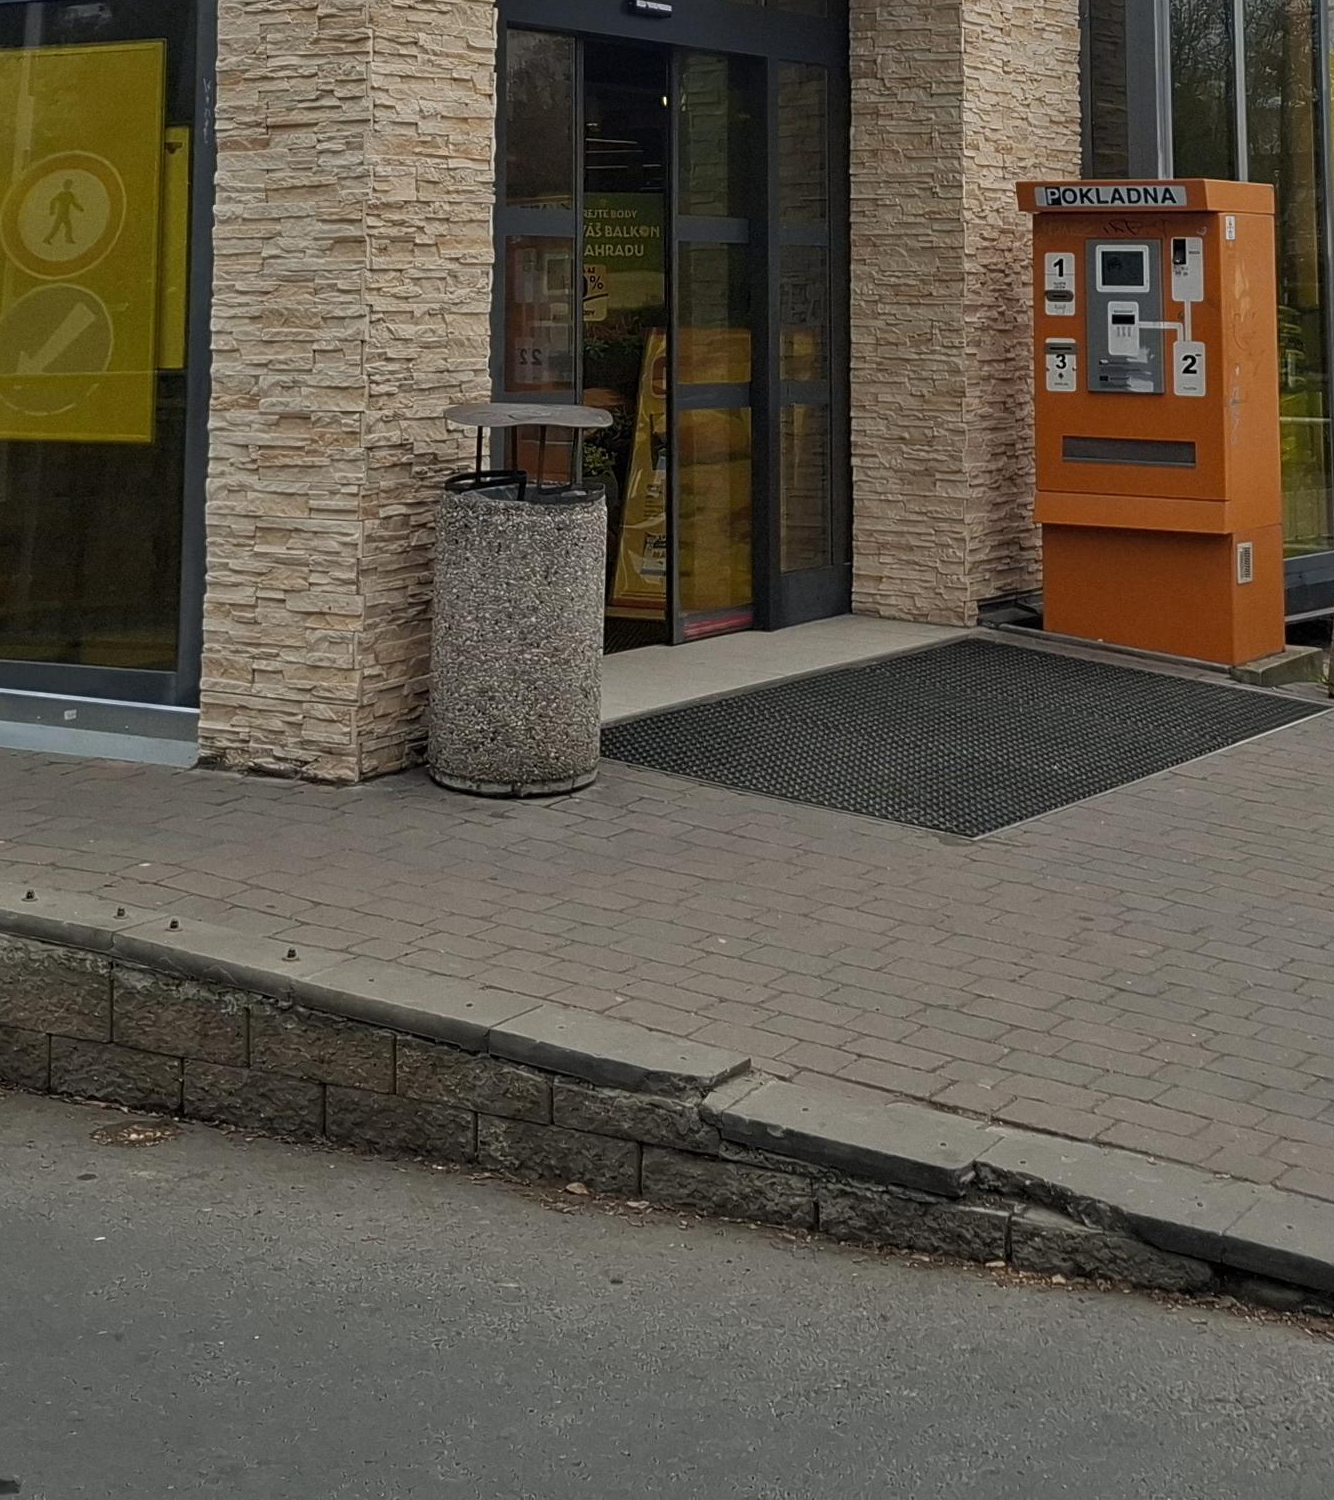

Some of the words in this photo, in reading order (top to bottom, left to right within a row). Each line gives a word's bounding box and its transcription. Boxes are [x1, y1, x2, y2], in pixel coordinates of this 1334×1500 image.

[1045, 186, 1177, 206] POKLADNA
[611, 209, 637, 218] BODY
[1053, 258, 1065, 277] 1
[1055, 354, 1066, 370] 3
[1182, 355, 1197, 375] 2
